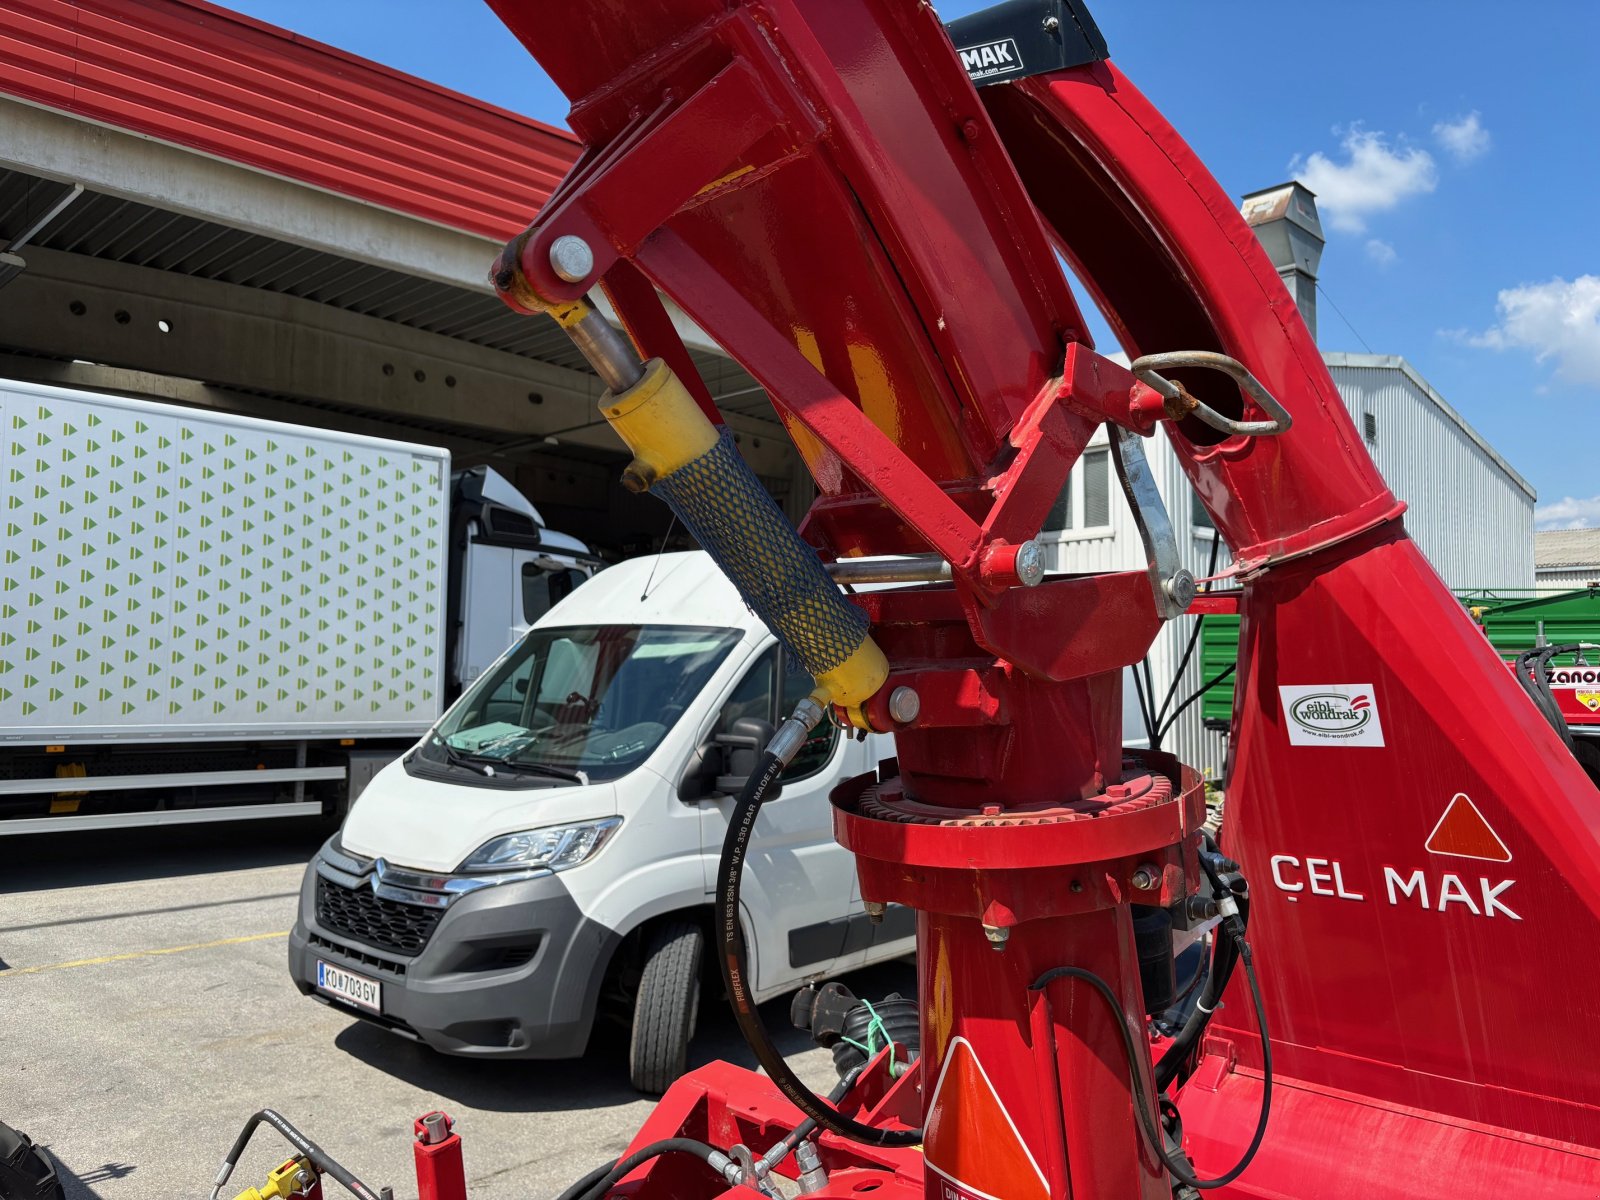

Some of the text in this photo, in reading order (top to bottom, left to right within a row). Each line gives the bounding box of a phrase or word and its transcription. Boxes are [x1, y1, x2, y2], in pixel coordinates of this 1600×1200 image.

[960, 43, 1013, 70] MAK
[1299, 708, 1359, 720] wondrak
[768, 763, 778, 774] IN
[753, 773, 771, 801] MADE
[742, 803, 756, 825] BAR
[737, 827, 748, 842] 330
[1270, 855, 1524, 920] ÇEL MAK
[726, 903, 734, 918] 853
[726, 918, 734, 931] EN
[731, 969, 745, 1002] FIREFLEX
